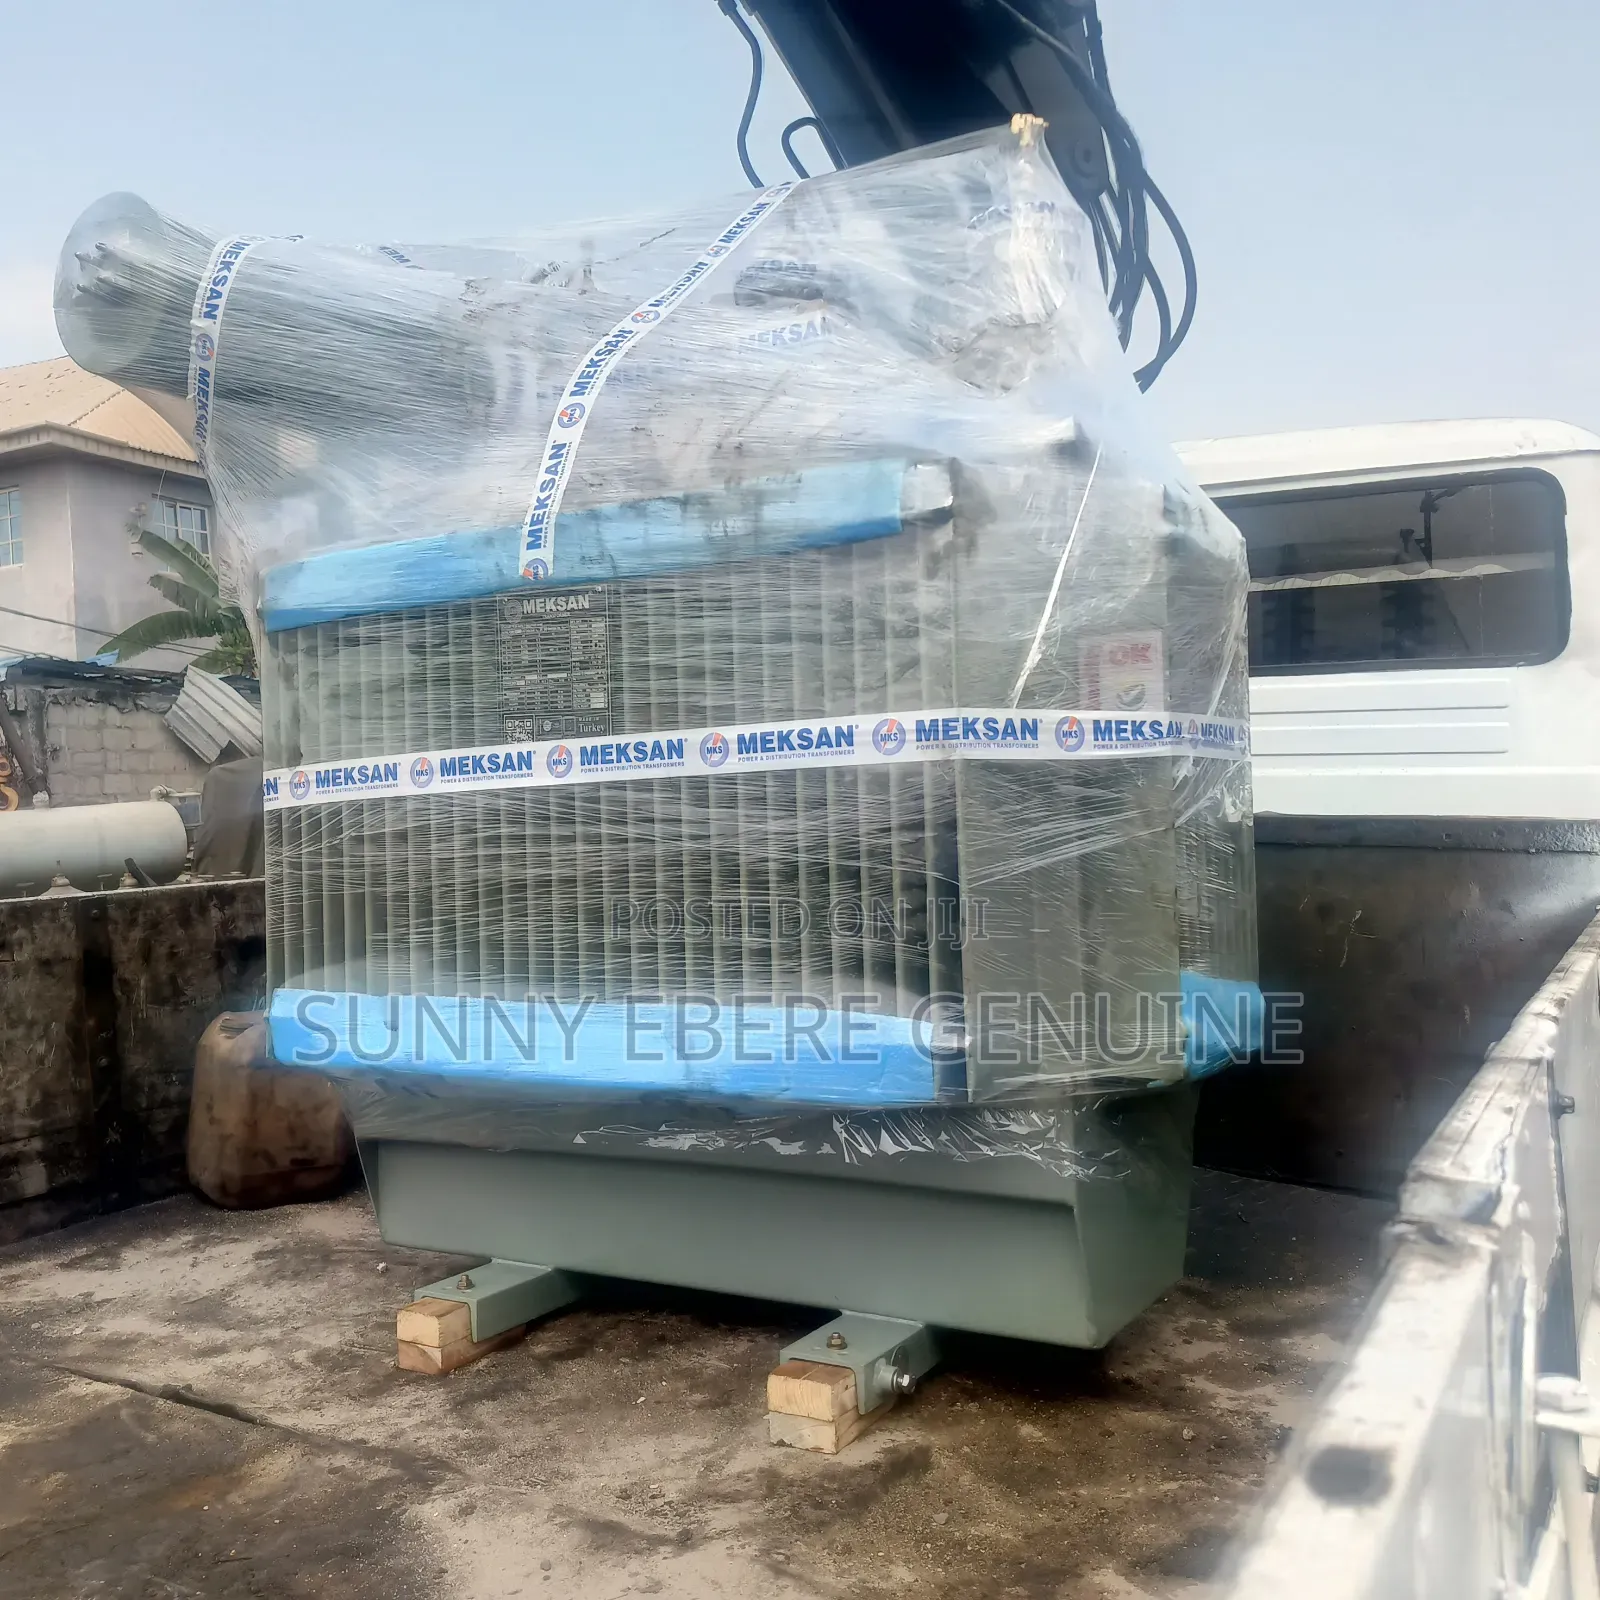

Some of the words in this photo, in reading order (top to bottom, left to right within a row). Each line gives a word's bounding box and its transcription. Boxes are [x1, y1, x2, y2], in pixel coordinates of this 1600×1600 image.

[203, 241, 251, 321] MEKSAN
[569, 329, 634, 397] MEKSAN
[557, 441, 573, 484] TRANSFORMERS
[526, 442, 568, 550] MEKSAN
[523, 594, 590, 614] MEKSAN
[578, 722, 606, 734] Turkey
[879, 732, 899, 742] MKS
[915, 717, 1038, 742] MEKSAN
[1062, 730, 1079, 739] MKS
[1092, 719, 1183, 741] MEKSAN
[1201, 722, 1235, 743] MEKSAN
[737, 724, 854, 755] MEKSAN
[1120, 741, 1157, 749] DISTRIBUTION
[580, 738, 684, 766] MEKSAN
[706, 745, 723, 755] MKS
[738, 755, 759, 763] POWER
[766, 752, 806, 761] DISTRIBUTION
[807, 749, 855, 758] TRANSFORMERS
[440, 750, 533, 777] MEKSAN
[552, 758, 567, 766] MKS
[605, 763, 642, 772] DISTRIBUTION
[643, 761, 685, 769] TRANSFORMERS
[315, 762, 398, 788] MEKSAN
[415, 768, 429, 777] MKS
[462, 775, 495, 783] DISTRIBUTION
[496, 772, 534, 780] TRANSFORMERS
